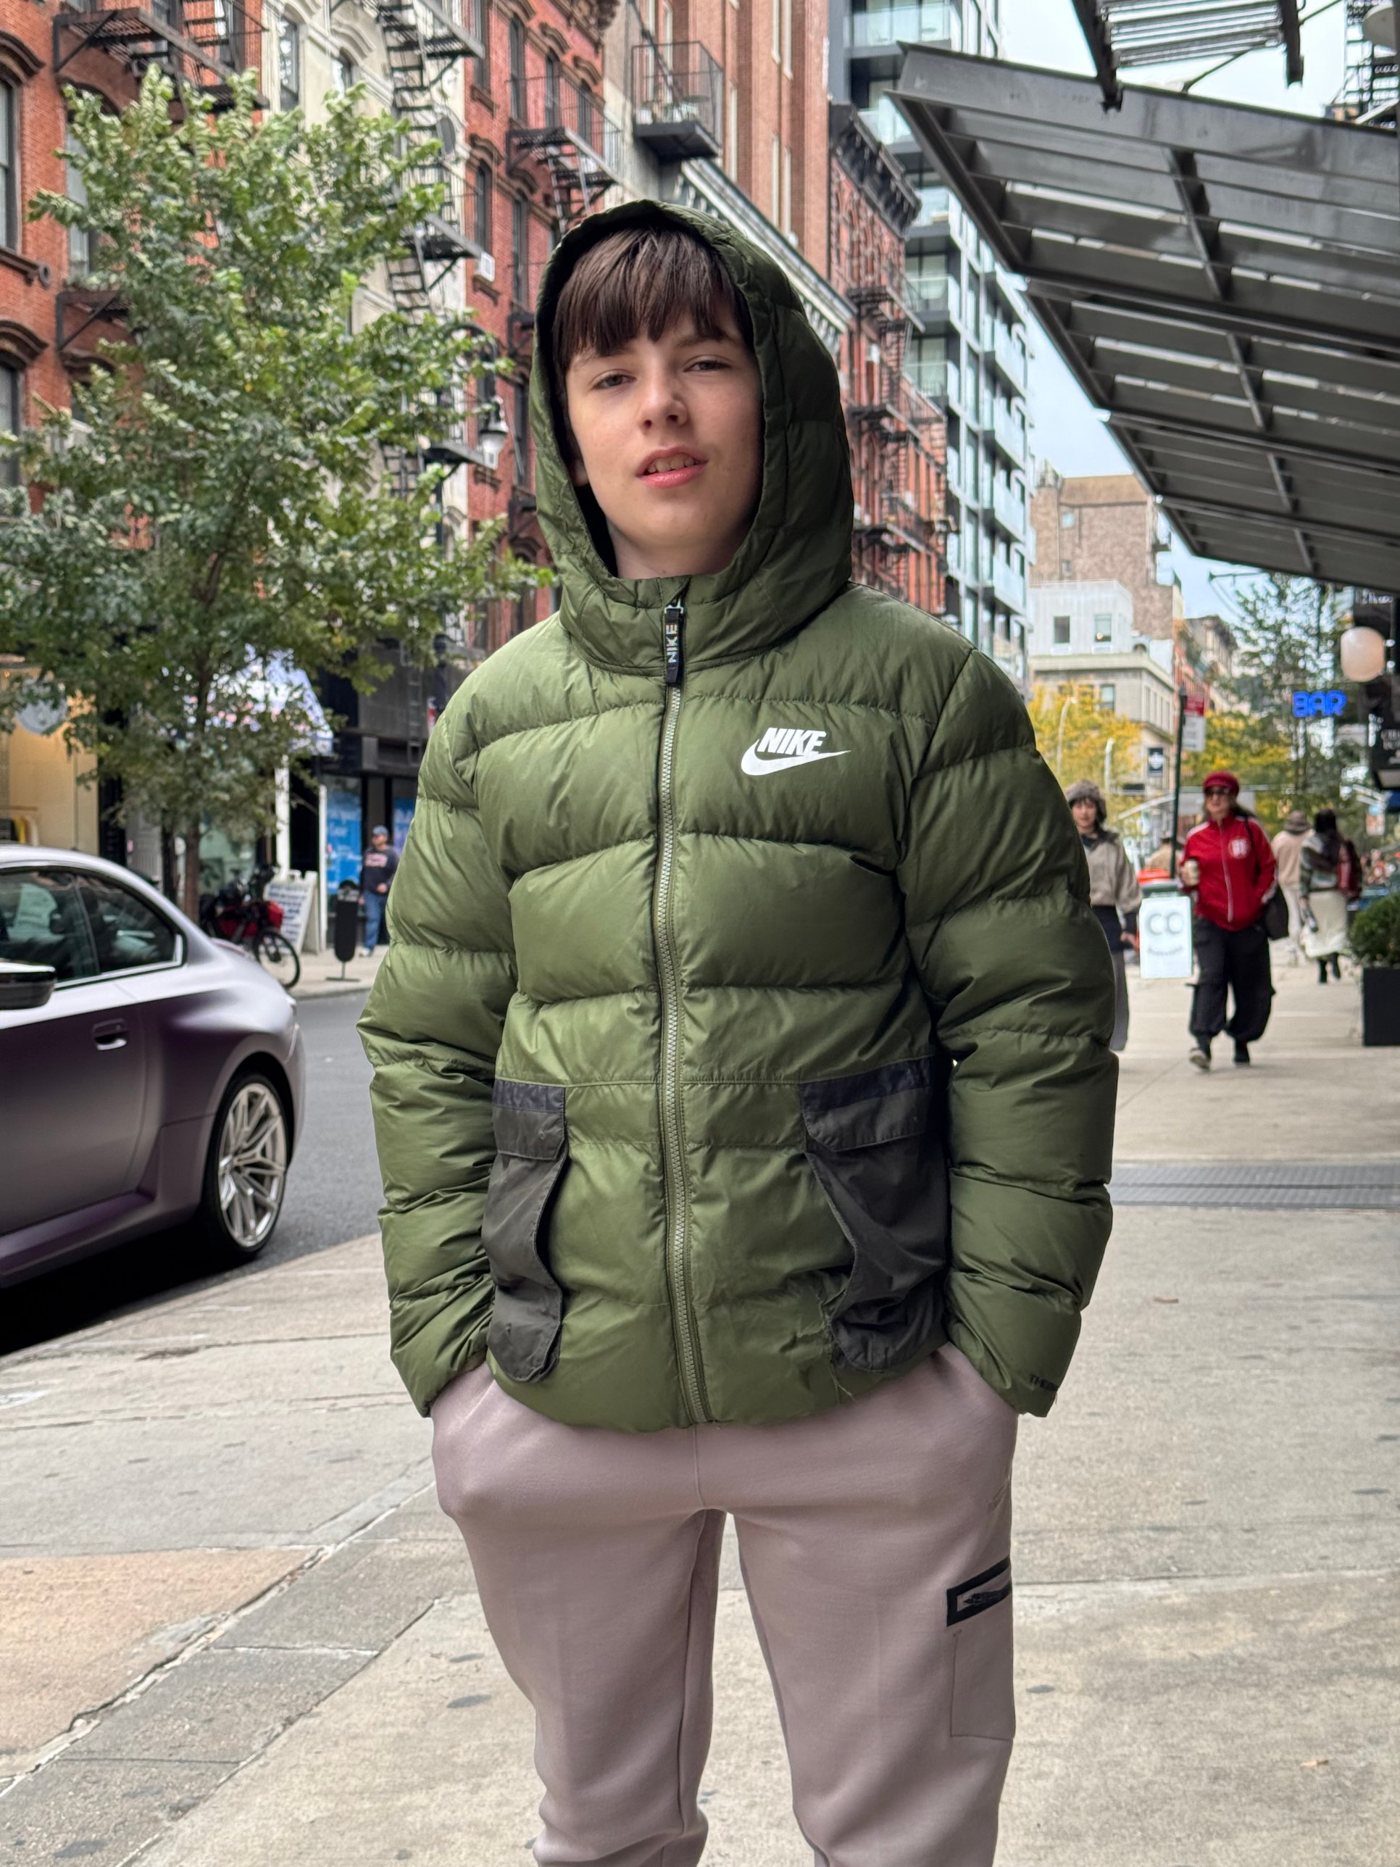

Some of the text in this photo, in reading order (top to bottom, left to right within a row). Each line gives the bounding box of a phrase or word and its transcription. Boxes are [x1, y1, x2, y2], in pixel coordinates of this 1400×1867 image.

[666, 624, 678, 663] NIKE
[1292, 690, 1346, 717] BAR
[757, 727, 827, 756] NIKE
